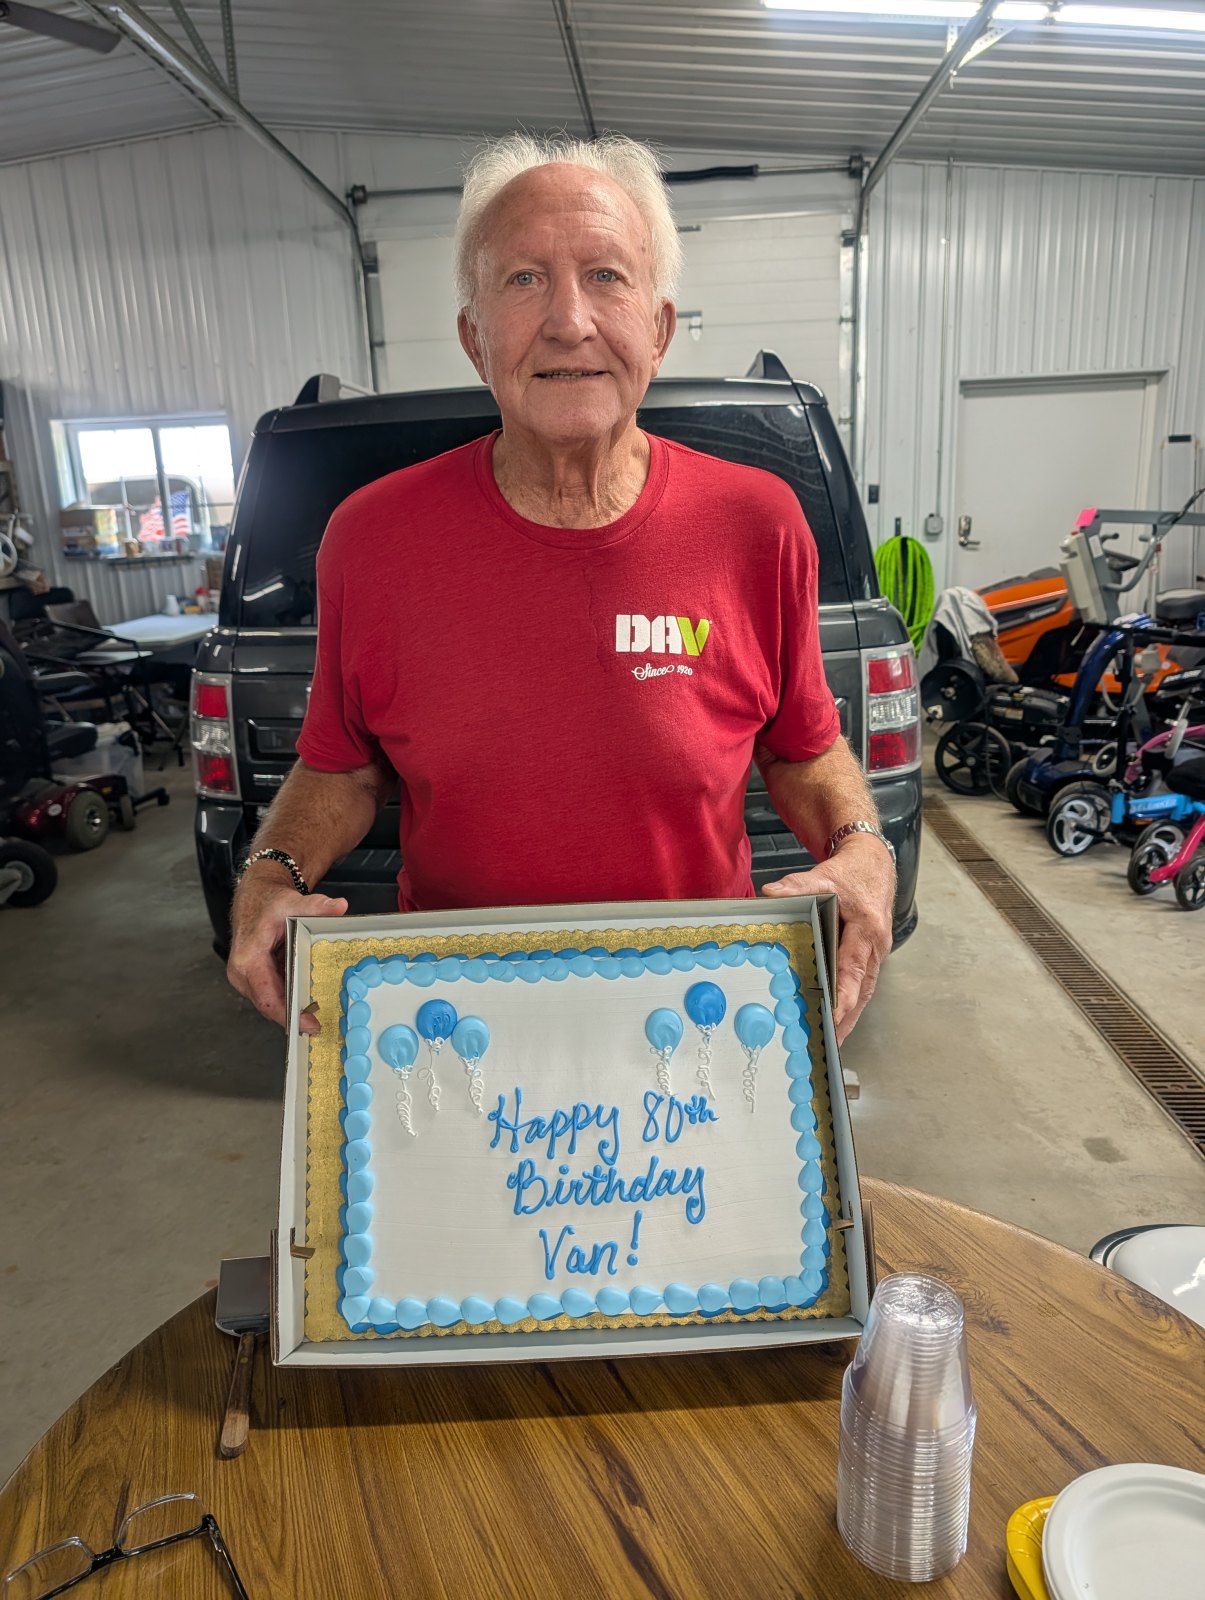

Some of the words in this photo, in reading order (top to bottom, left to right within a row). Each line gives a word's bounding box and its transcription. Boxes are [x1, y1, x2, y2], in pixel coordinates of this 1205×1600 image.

[616, 614, 710, 656] DAV
[631, 663, 674, 680] Since
[676, 665, 693, 676] 1920
[487, 1087, 620, 1166] Happy
[642, 1090, 719, 1143] 80th
[506, 1155, 706, 1224] Birthday
[539, 1210, 643, 1280] Van!
